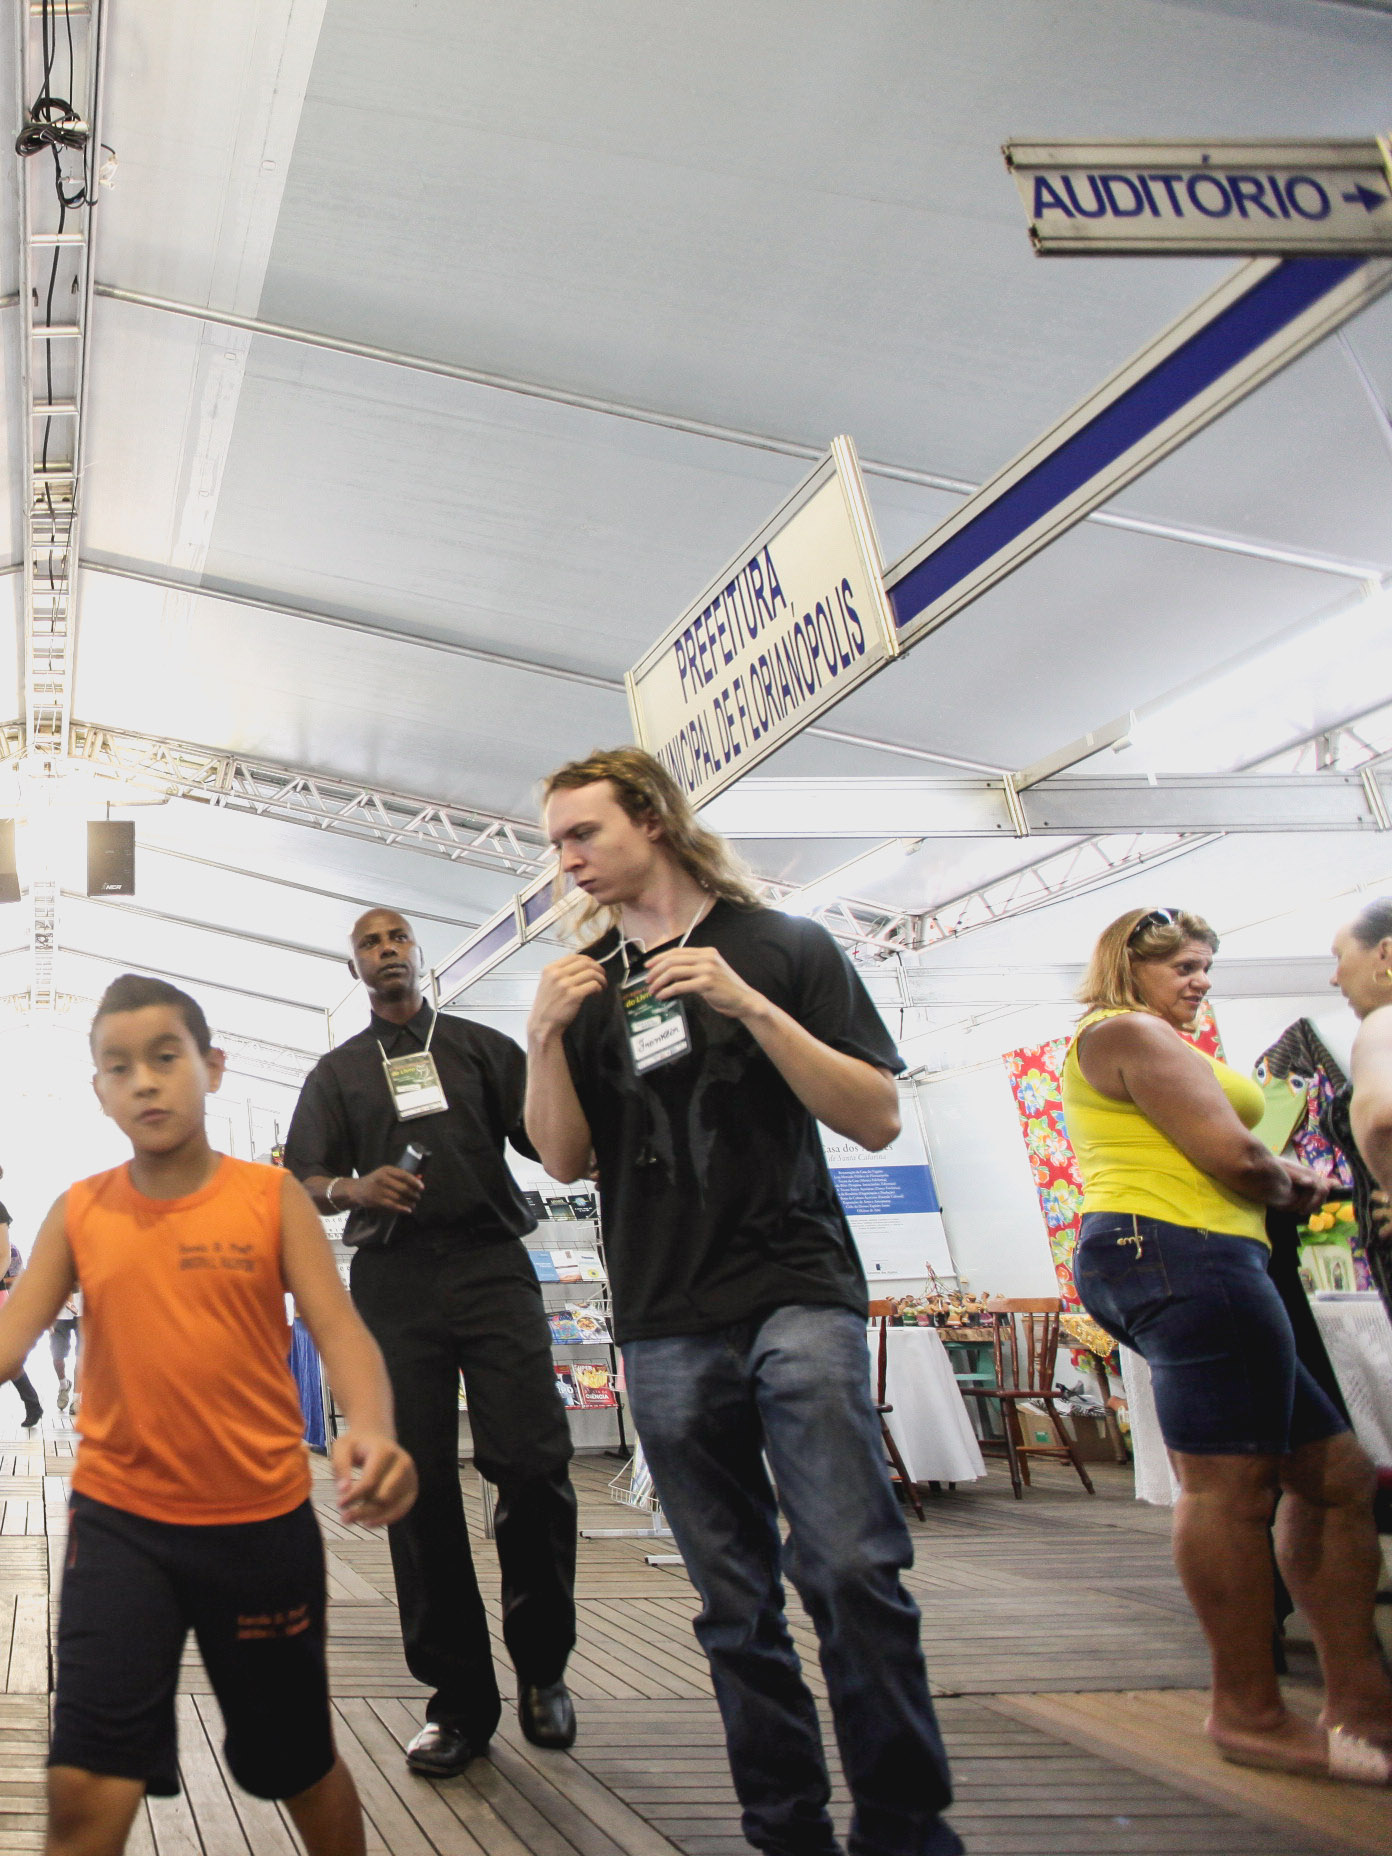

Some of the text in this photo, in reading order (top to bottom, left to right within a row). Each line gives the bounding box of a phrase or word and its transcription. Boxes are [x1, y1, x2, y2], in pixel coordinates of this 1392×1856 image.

[657, 577, 866, 796] UNICIPAL DE FLORIANÓPOLIS
[674, 544, 787, 704] PREFEITURA
[842, 1143, 859, 1153] dos
